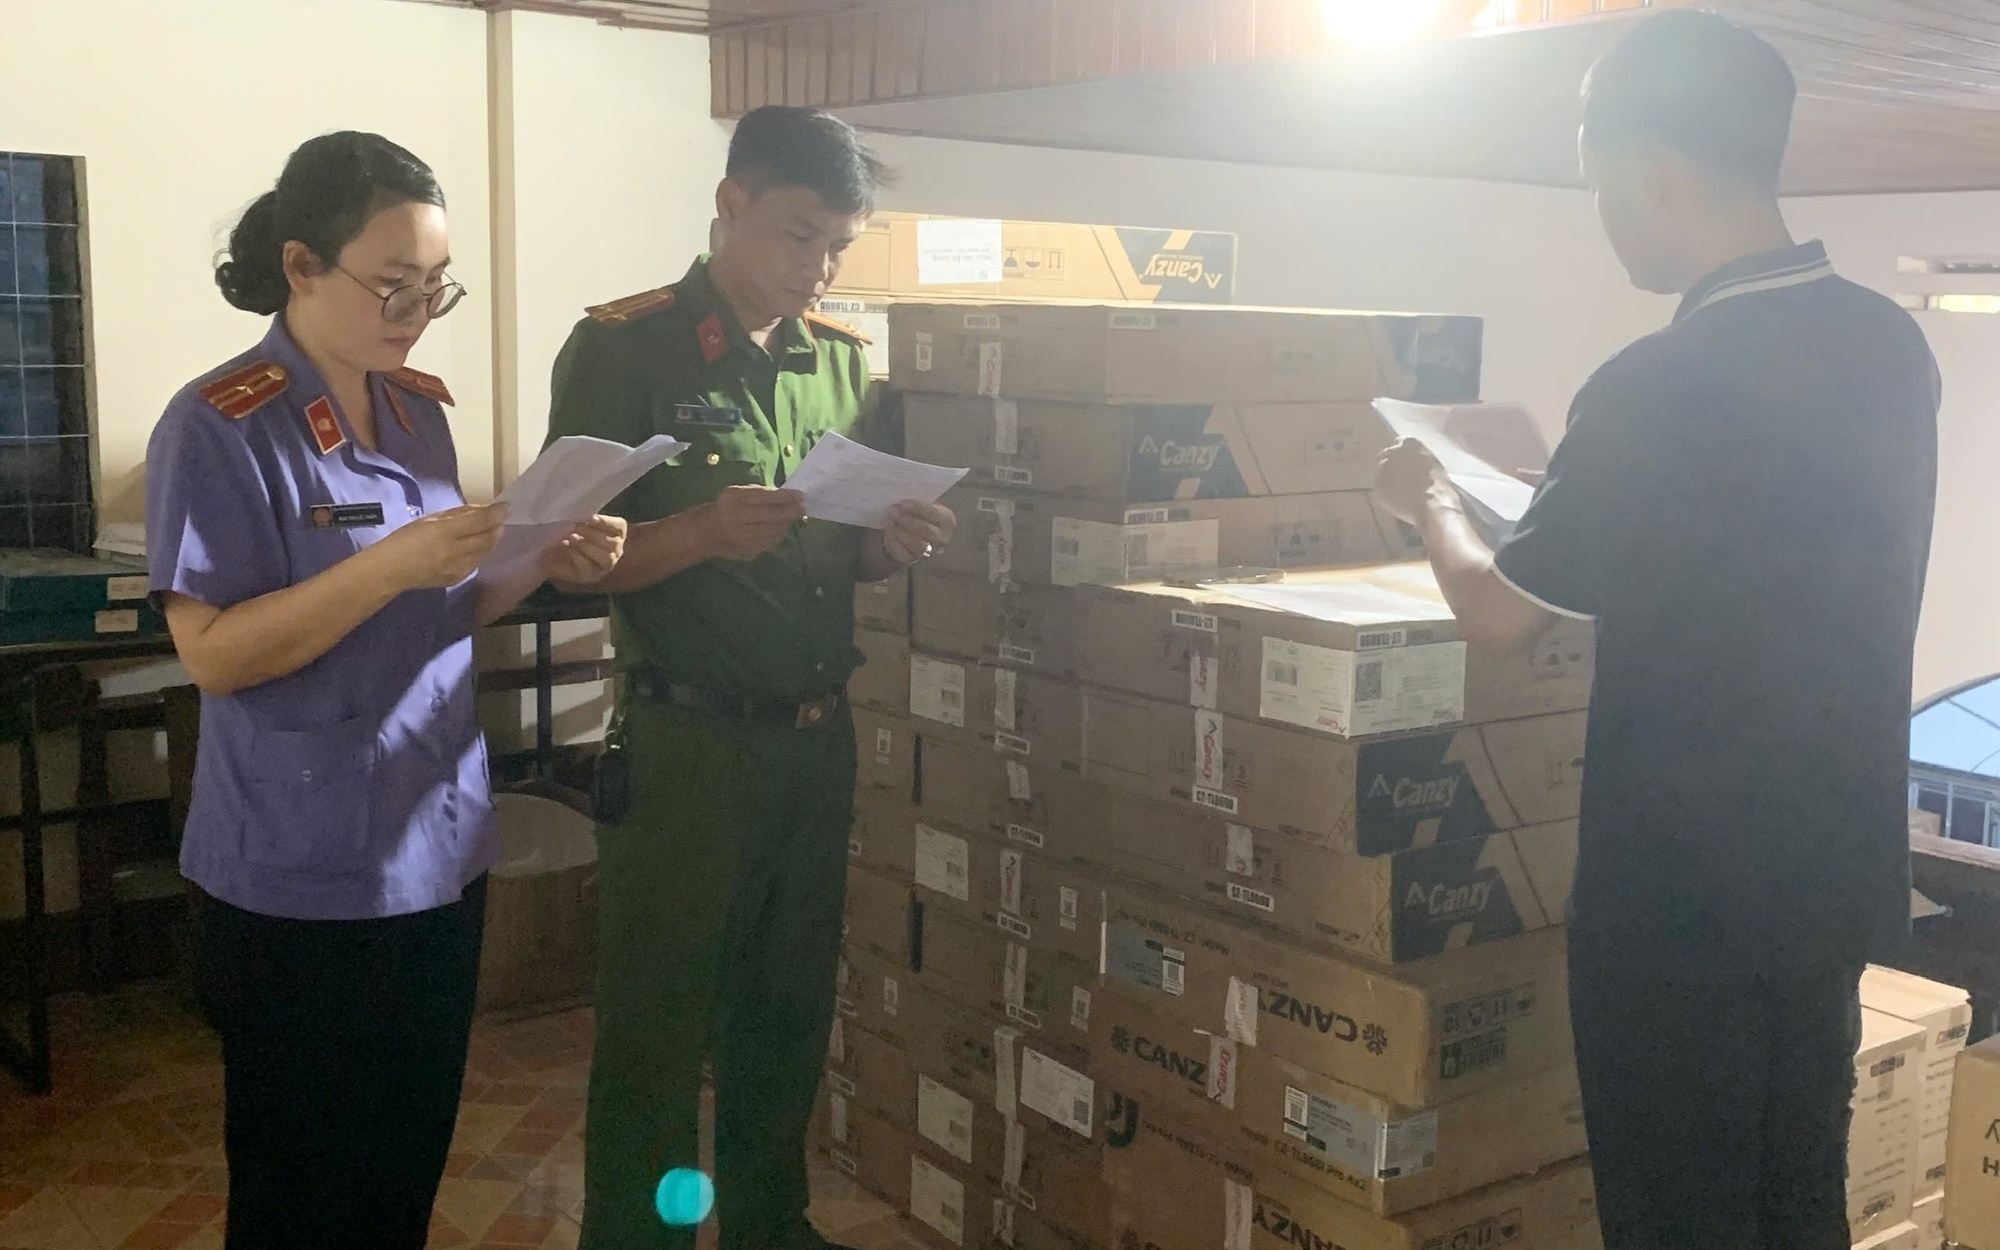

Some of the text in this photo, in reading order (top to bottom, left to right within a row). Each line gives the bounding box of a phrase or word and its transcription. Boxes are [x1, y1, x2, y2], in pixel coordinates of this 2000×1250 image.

[1143, 253, 1203, 283] Canzy
[1161, 440, 1219, 471] Canzy
[1393, 777, 1459, 808] Canzy
[1428, 882, 1494, 915] Canzy
[1134, 1036, 1209, 1086] CANZ
